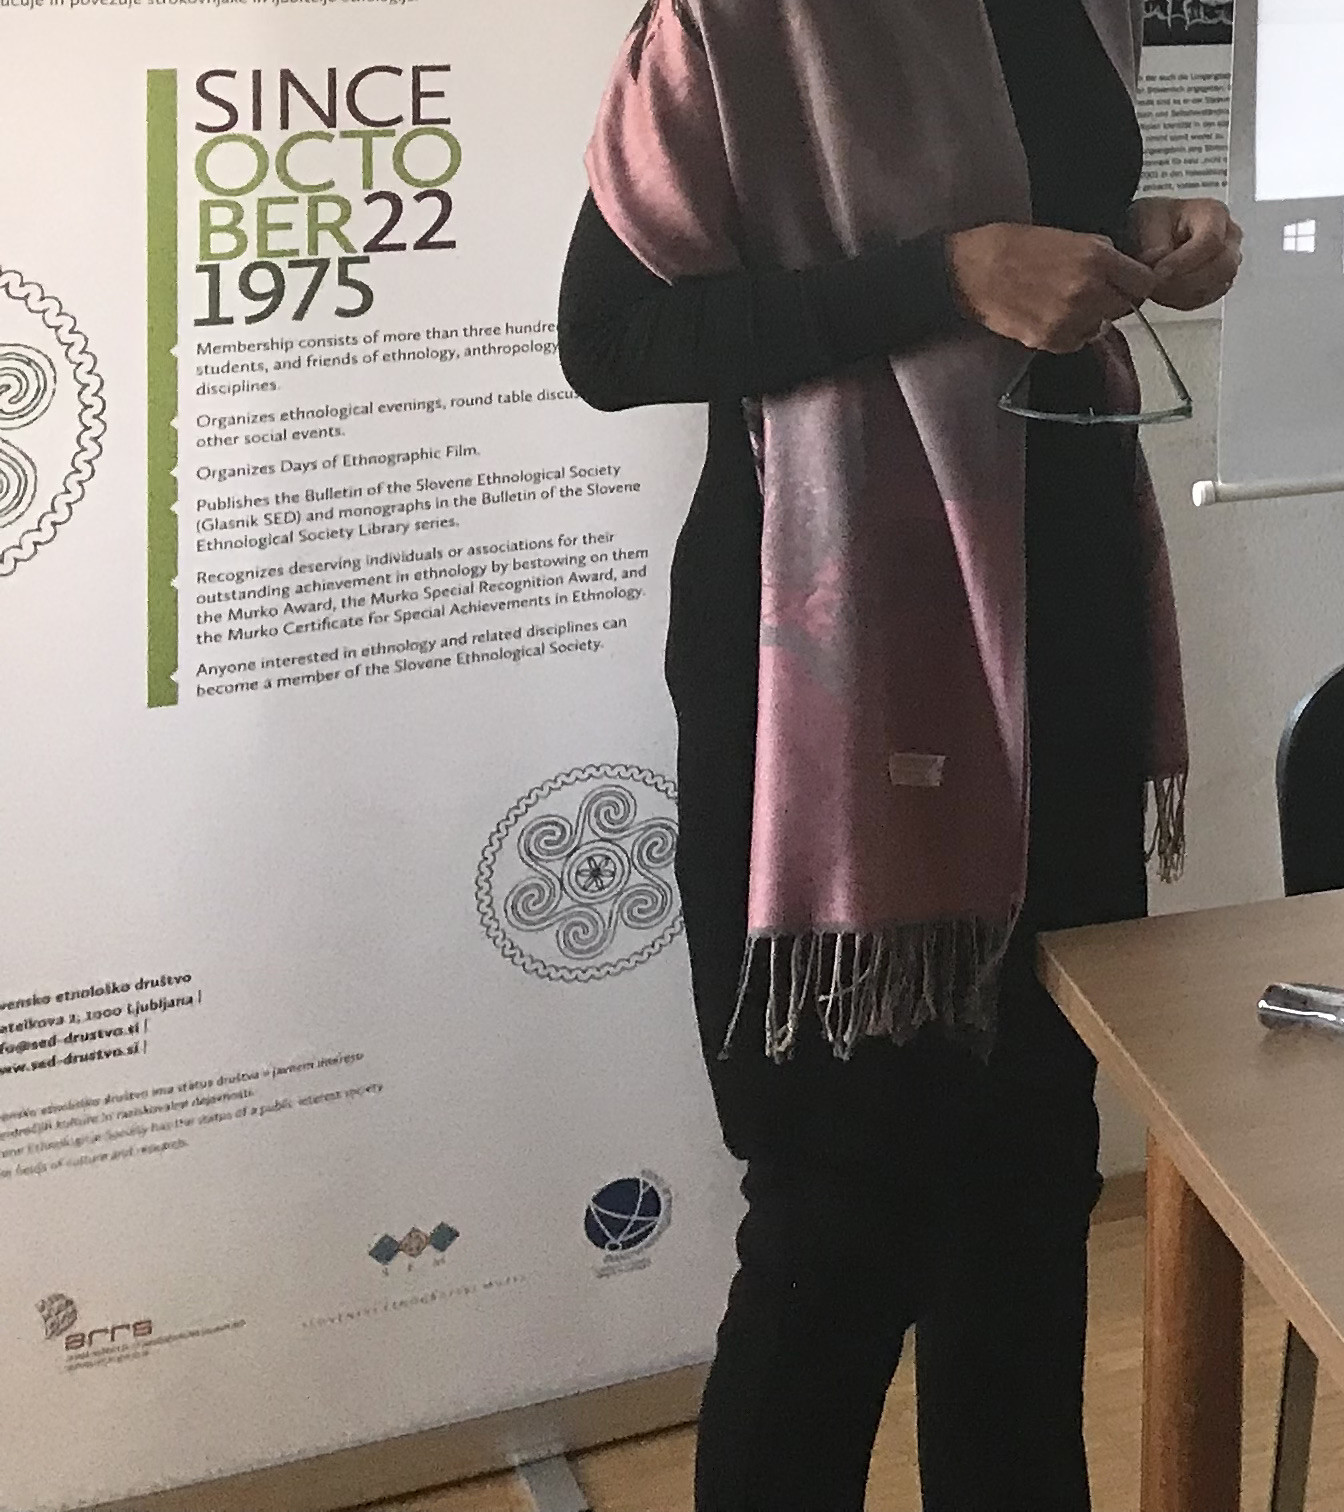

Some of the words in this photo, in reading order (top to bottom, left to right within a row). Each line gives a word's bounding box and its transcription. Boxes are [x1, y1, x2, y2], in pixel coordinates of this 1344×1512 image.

[195, 64, 452, 133] SINCE
[194, 126, 462, 197] OCTO
[193, 255, 374, 328] 1975
[197, 337, 293, 356] Membership
[298, 334, 358, 349] consists
[363, 330, 379, 345] of
[384, 331, 421, 343] more
[426, 326, 458, 341] than
[463, 324, 501, 338] three
[197, 359, 268, 376] students,
[274, 355, 301, 371] and
[307, 351, 358, 368] friends
[363, 349, 379, 364] of
[383, 346, 460, 363] ethnology,
[196, 464, 276, 483] Organizes
[281, 460, 317, 474] Days
[322, 454, 338, 470] of
[343, 447, 440, 467] Ethnographic
[446, 444, 480, 458] Film.
[197, 495, 269, 512] Publishes
[275, 492, 299, 506] the
[305, 486, 362, 503] Bulletin
[367, 481, 384, 496] of
[387, 481, 411, 494] the
[416, 476, 473, 493] Slovene
[477, 466, 565, 487] Ethnological
[570, 464, 621, 479] Society
[197, 530, 293, 553] Ethnological
[299, 527, 354, 543] Society
[359, 521, 410, 537] Library
[415, 517, 459, 532] series.
